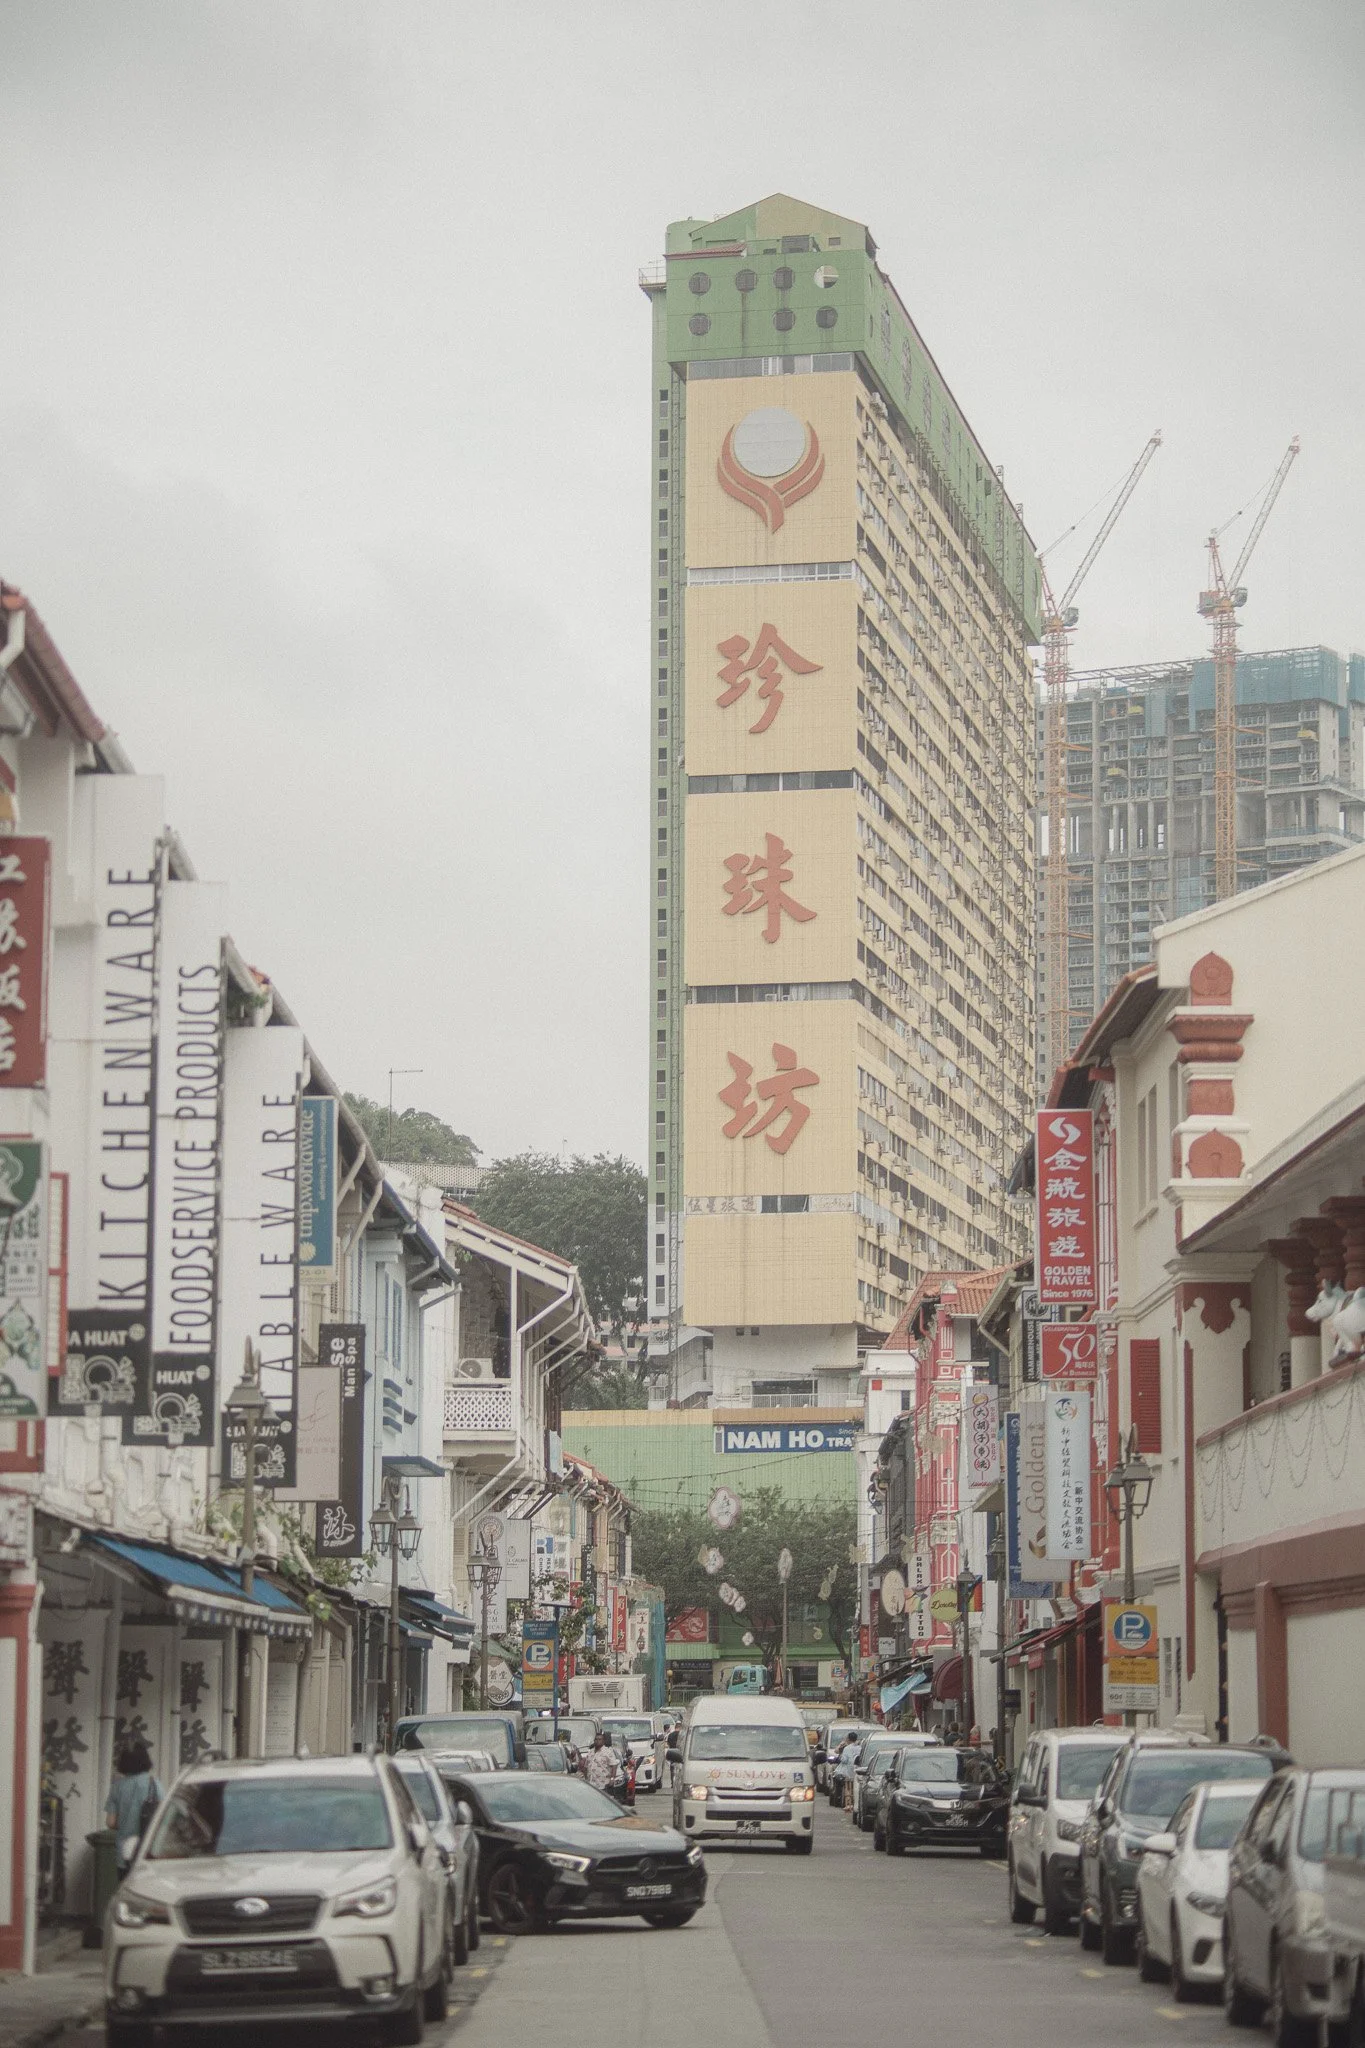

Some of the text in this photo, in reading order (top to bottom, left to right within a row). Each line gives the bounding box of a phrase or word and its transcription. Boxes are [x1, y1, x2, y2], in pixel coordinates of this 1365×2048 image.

[716, 622, 824, 1155] 珍珠坊
[98, 868, 156, 1300] KITCHENWARE
[169, 964, 221, 1344] FOODSERVICE PRODUCTS
[1044, 1266, 1091, 1276] GOLDEN
[1044, 1276, 1091, 1286] TRAVEL
[1042, 1289, 1094, 1299] Since 1976
[84, 1329, 128, 1346] HUAT
[1044, 1325, 1096, 1378] 50
[156, 1370, 195, 1385] HUAT
[345, 1337, 358, 1398] Man Spa
[727, 1429, 854, 1449] NAM HO TRA
[1025, 1435, 1046, 1515] Golden
[916, 1556, 924, 1587] GALAX
[727, 1769, 786, 1780] SUNLOVE
